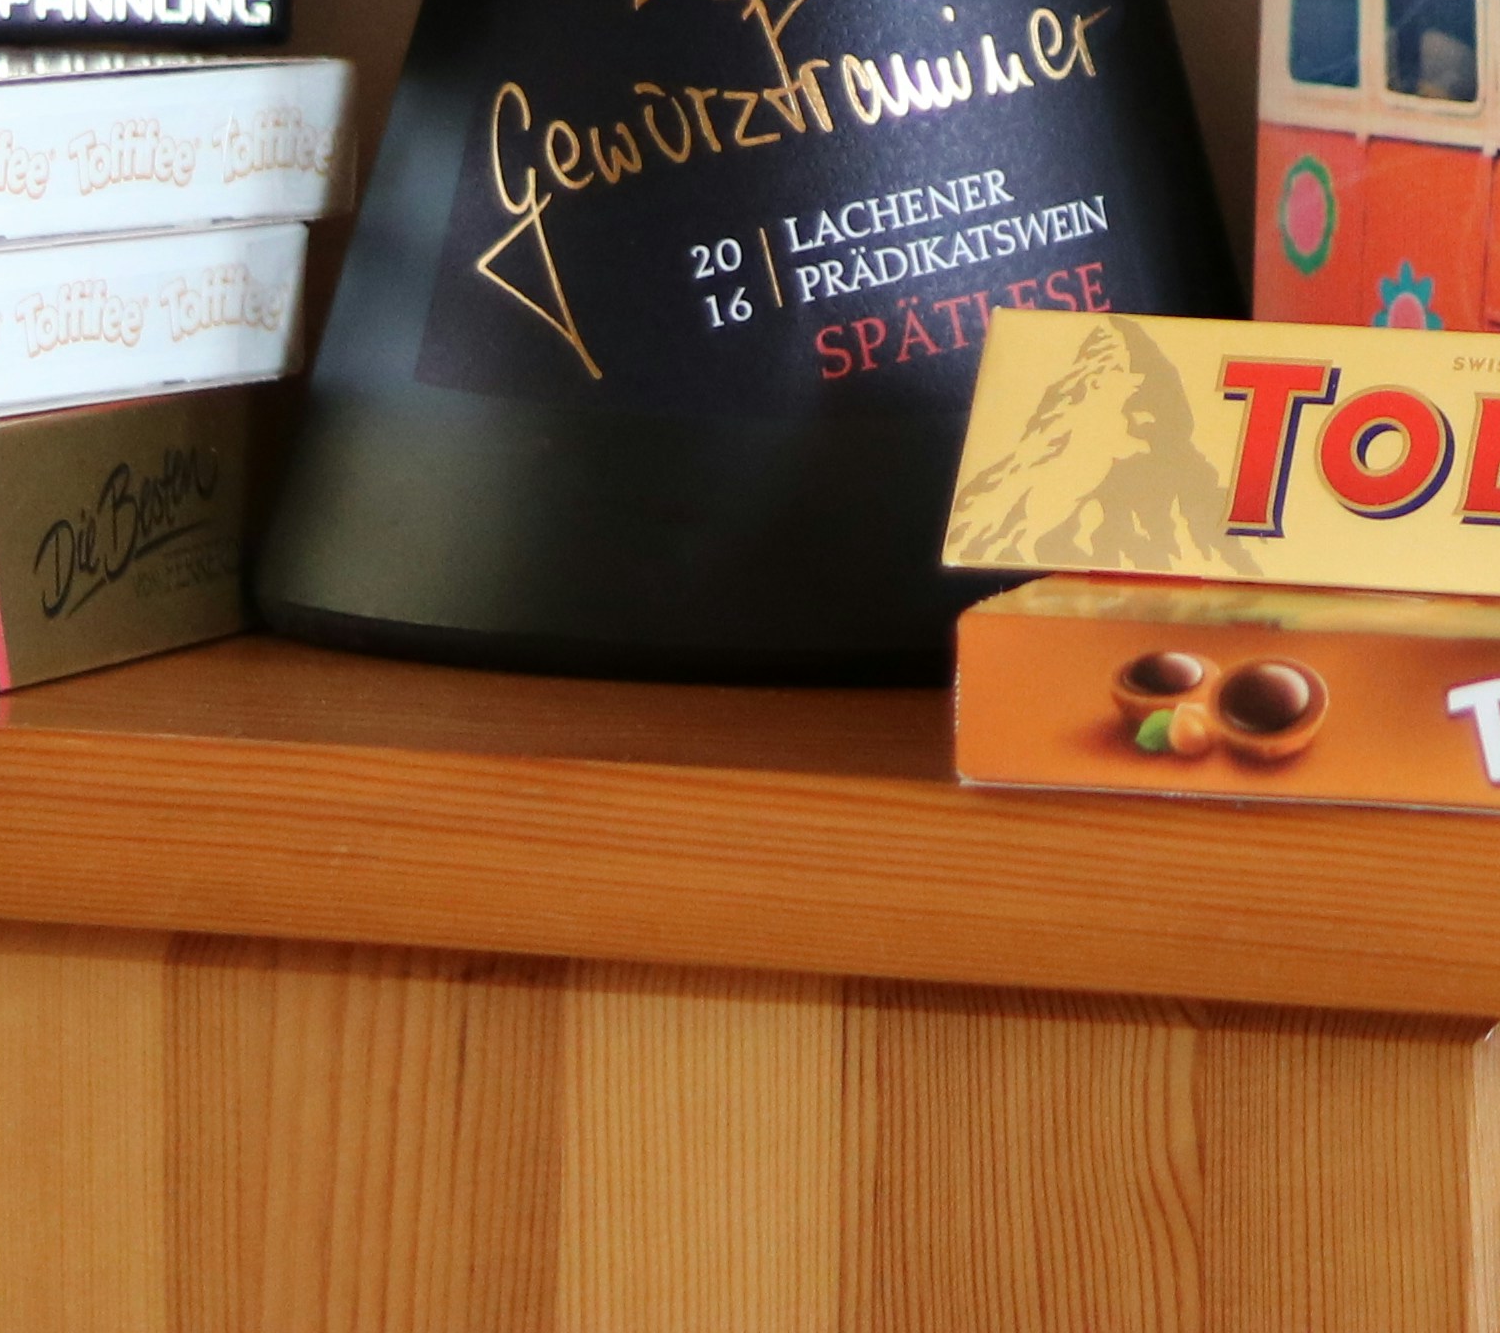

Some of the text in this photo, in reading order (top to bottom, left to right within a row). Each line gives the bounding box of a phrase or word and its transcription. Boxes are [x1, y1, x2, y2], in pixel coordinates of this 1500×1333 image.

[68, 118, 196, 196] Toffifee
[784, 169, 1015, 253] LACHENER
[796, 195, 1110, 303] PRÄDIKATSWEIN
[691, 237, 743, 279] 20
[14, 279, 144, 358] Toffifee
[704, 287, 753, 328] 16
[34, 507, 100, 619] Die
